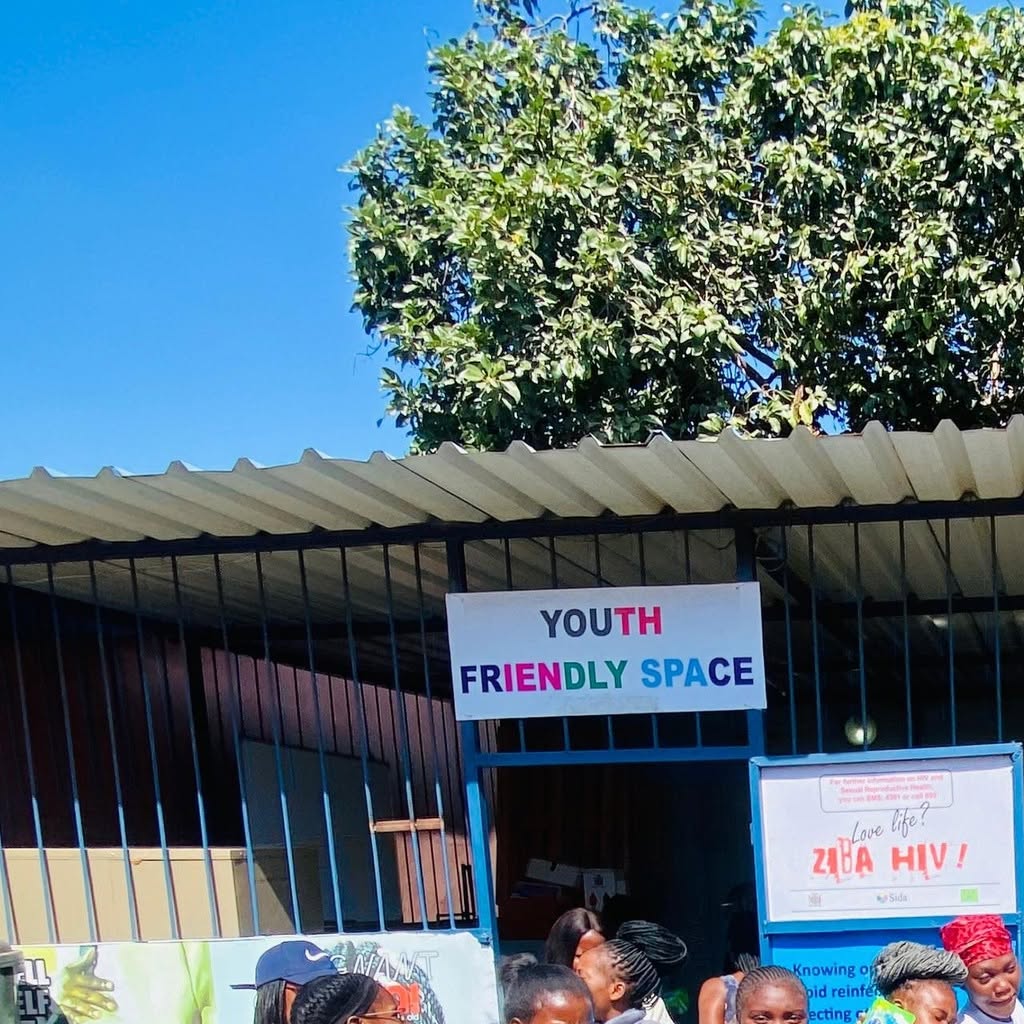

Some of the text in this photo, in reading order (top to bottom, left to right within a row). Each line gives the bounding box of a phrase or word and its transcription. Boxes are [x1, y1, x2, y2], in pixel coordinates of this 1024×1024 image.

[540, 606, 663, 638] YOUTH
[460, 656, 754, 694] FRIENDLY SPACE
[852, 801, 930, 844] Love life?
[891, 842, 947, 879] HIV
[793, 963, 855, 979] Knowing
